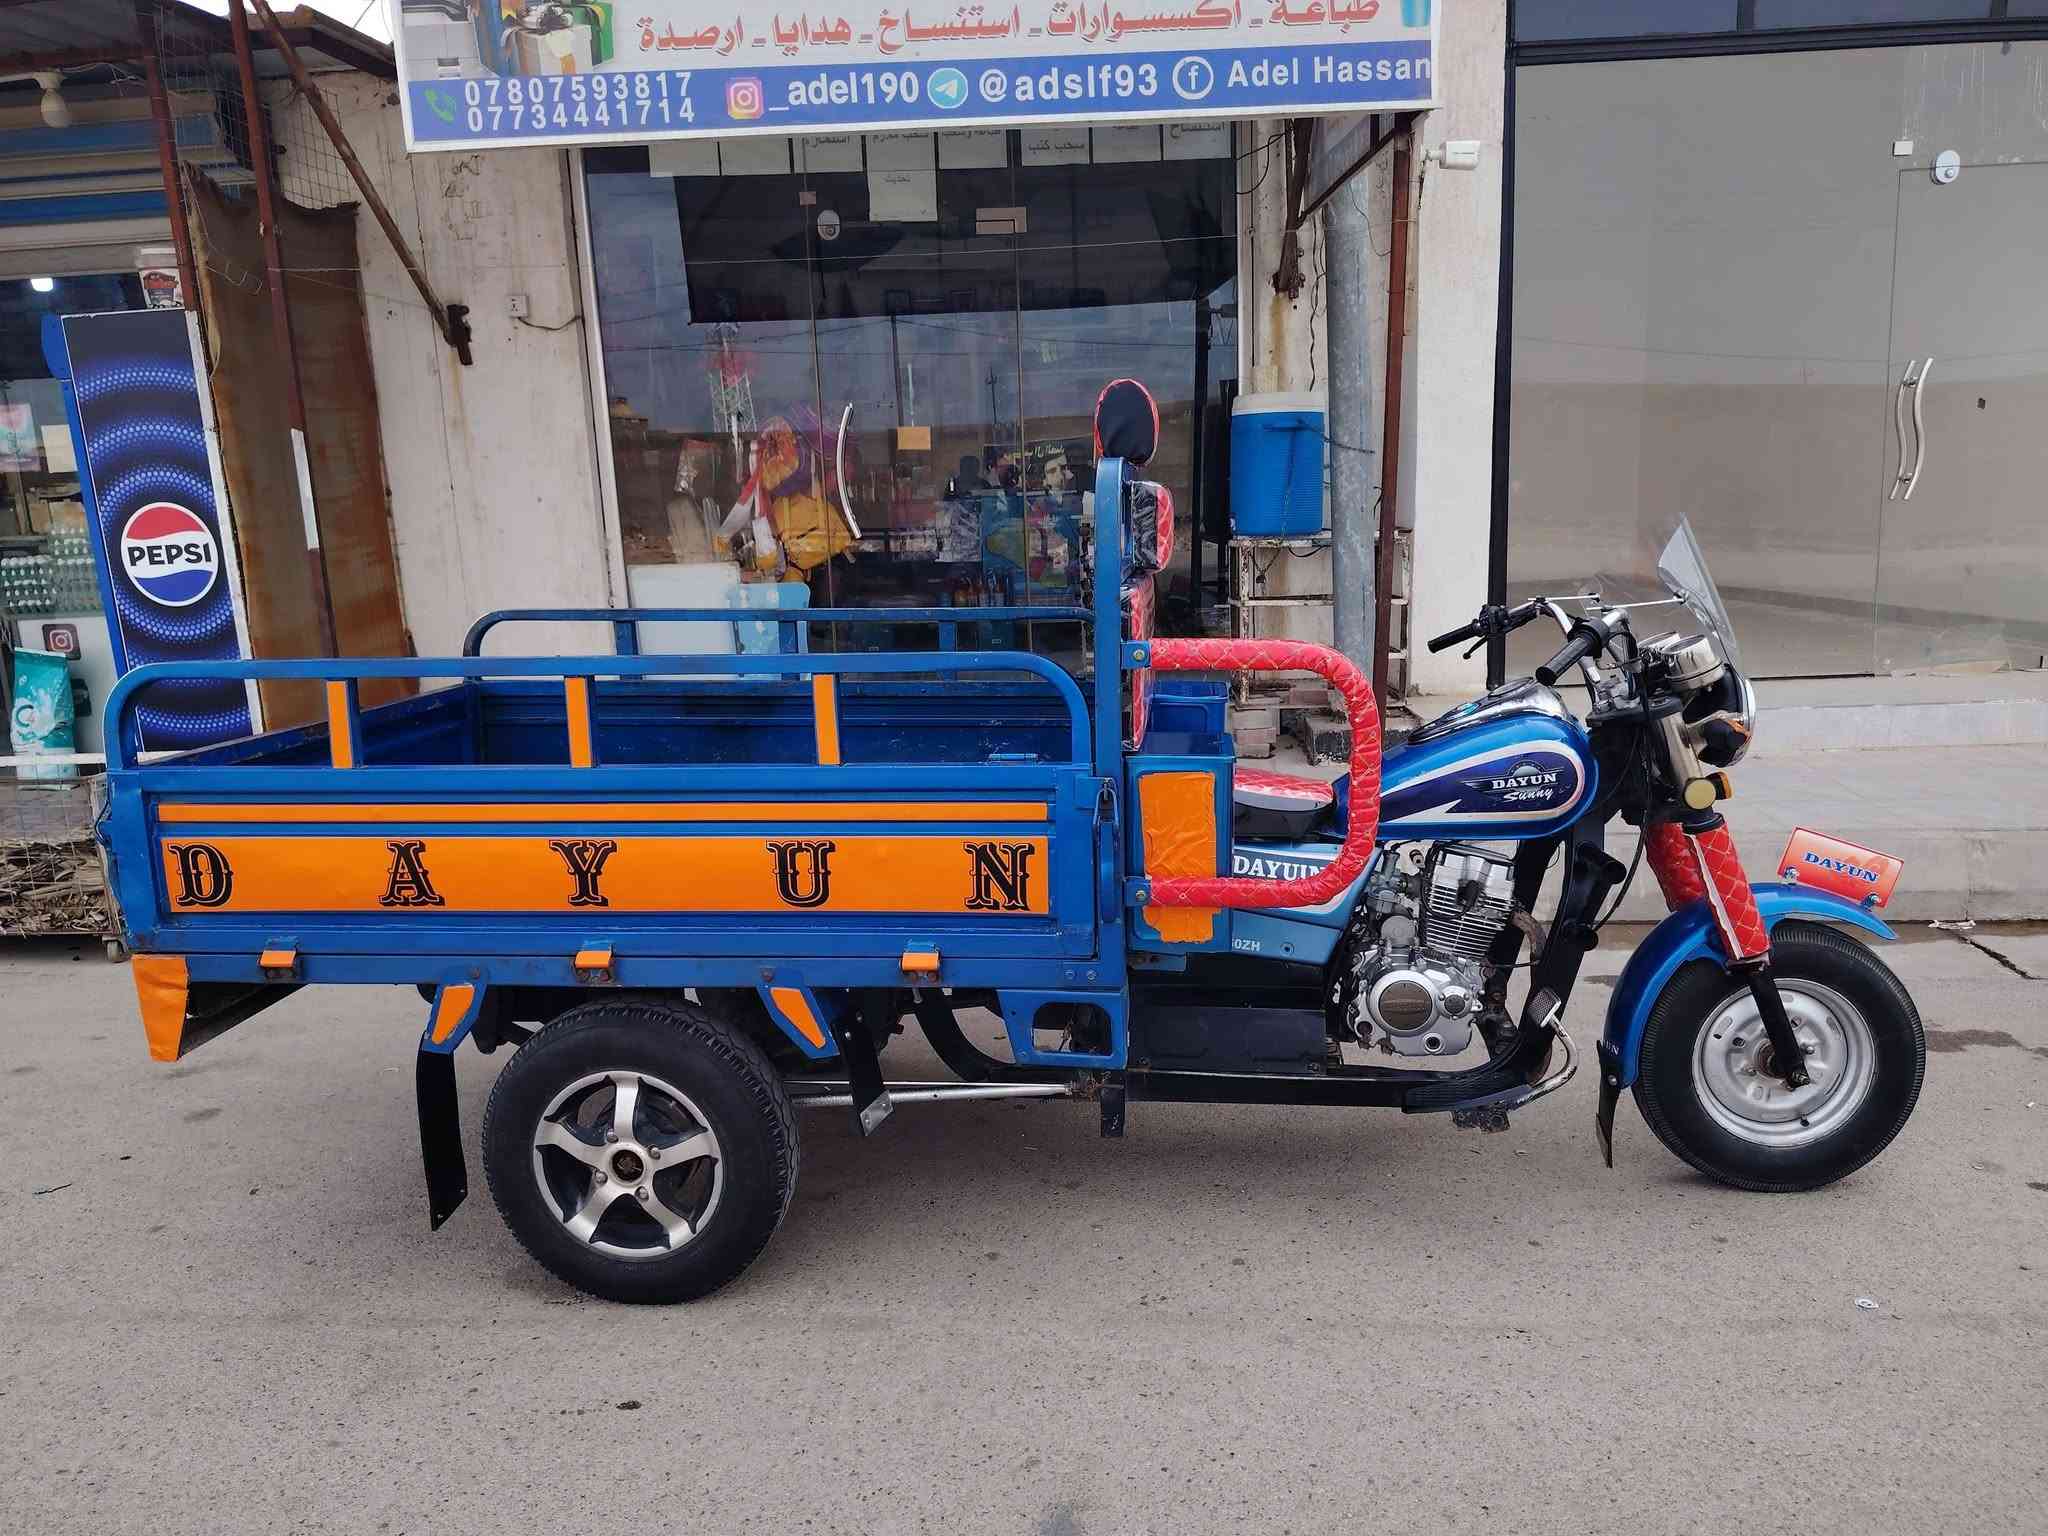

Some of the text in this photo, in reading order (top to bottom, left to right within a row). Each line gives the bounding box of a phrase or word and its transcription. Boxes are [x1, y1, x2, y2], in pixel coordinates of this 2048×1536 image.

[637, 15, 743, 56] ارصدة
[773, 13, 851, 56] هدايا
[879, 3, 1020, 55] استنساخ
[1227, 55, 1431, 88] Adel Hassan
[465, 71, 692, 107] 07807593817
[467, 97, 696, 133] 07734441714
[127, 542, 212, 566] PEPSI
[1491, 772, 1557, 790] DAYUN
[1503, 787, 1553, 803] Sunny
[1803, 851, 1878, 882] DAYUN
